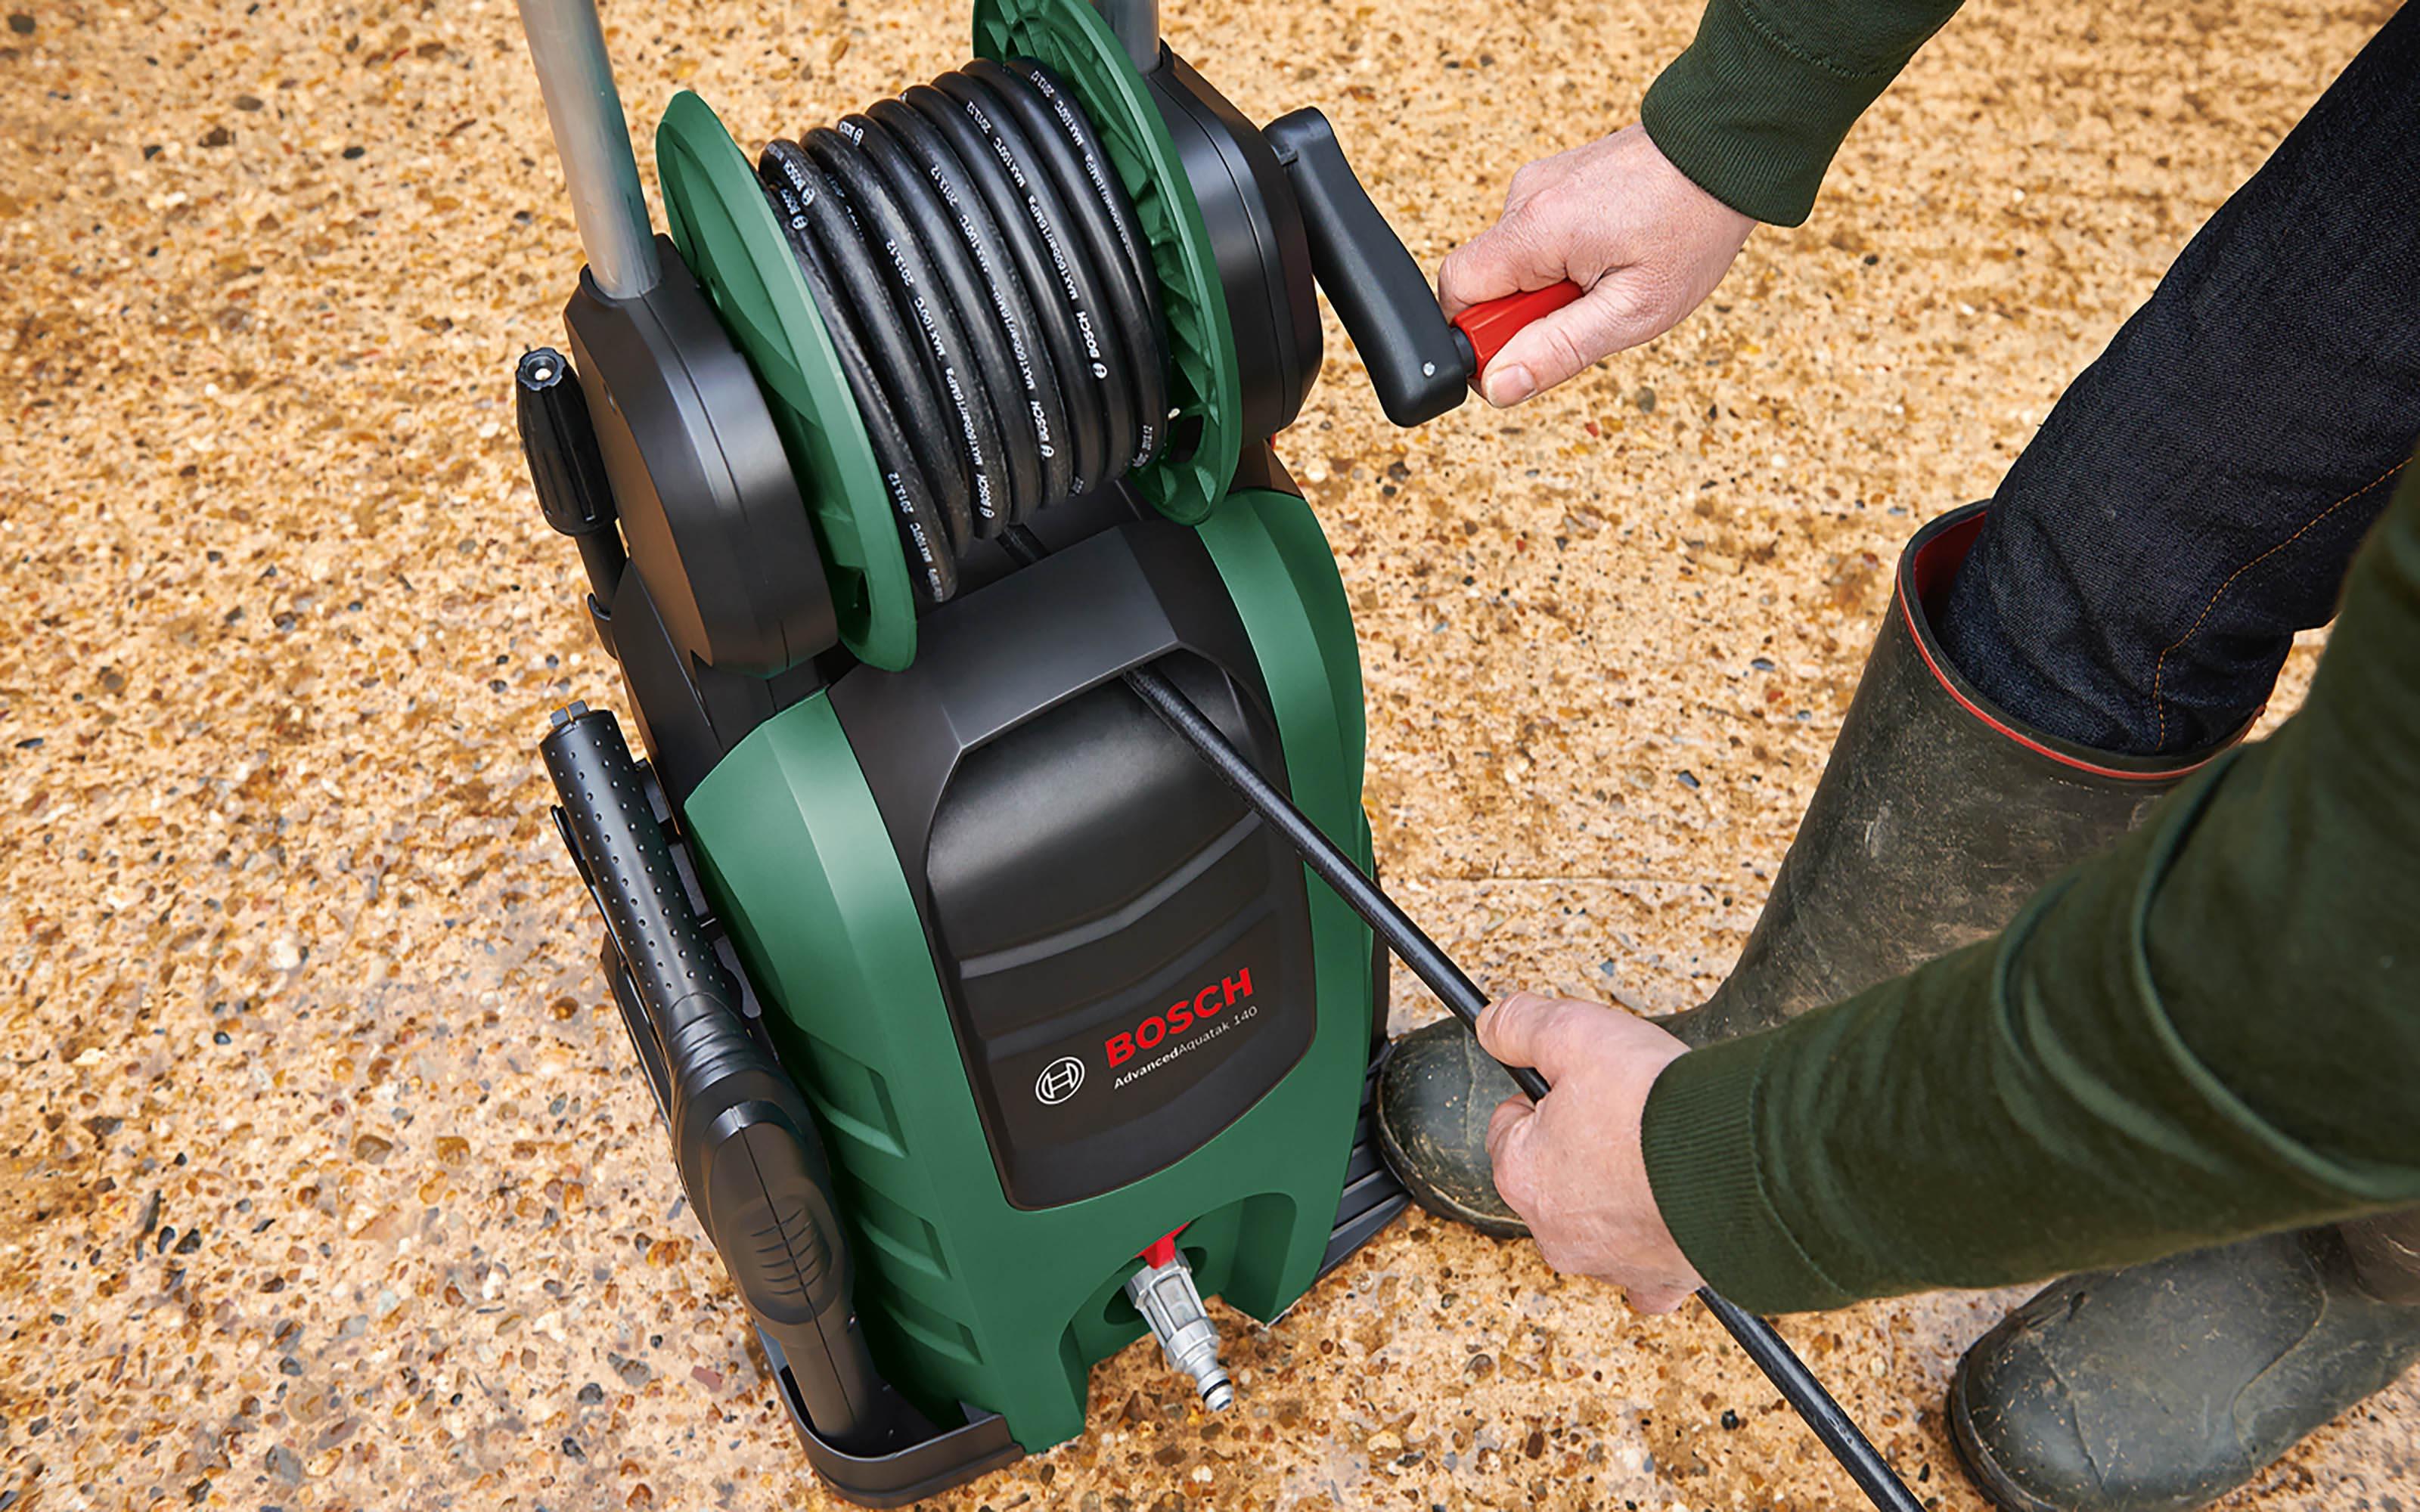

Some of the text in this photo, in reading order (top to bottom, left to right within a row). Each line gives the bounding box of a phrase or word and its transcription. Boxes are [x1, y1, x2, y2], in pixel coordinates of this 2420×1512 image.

[930, 164, 959, 206] 2013.12
[886, 236, 917, 287] 2013.12
[1076, 311, 1100, 358] BOSCH
[1030, 401, 1050, 442] BOSCH
[888, 472, 914, 513] 2013.12
[976, 474, 991, 507] BOSCH
[1105, 967, 1253, 1068] BOSCH
[1114, 1005, 1258, 1089] AdvancedAquatak 140
